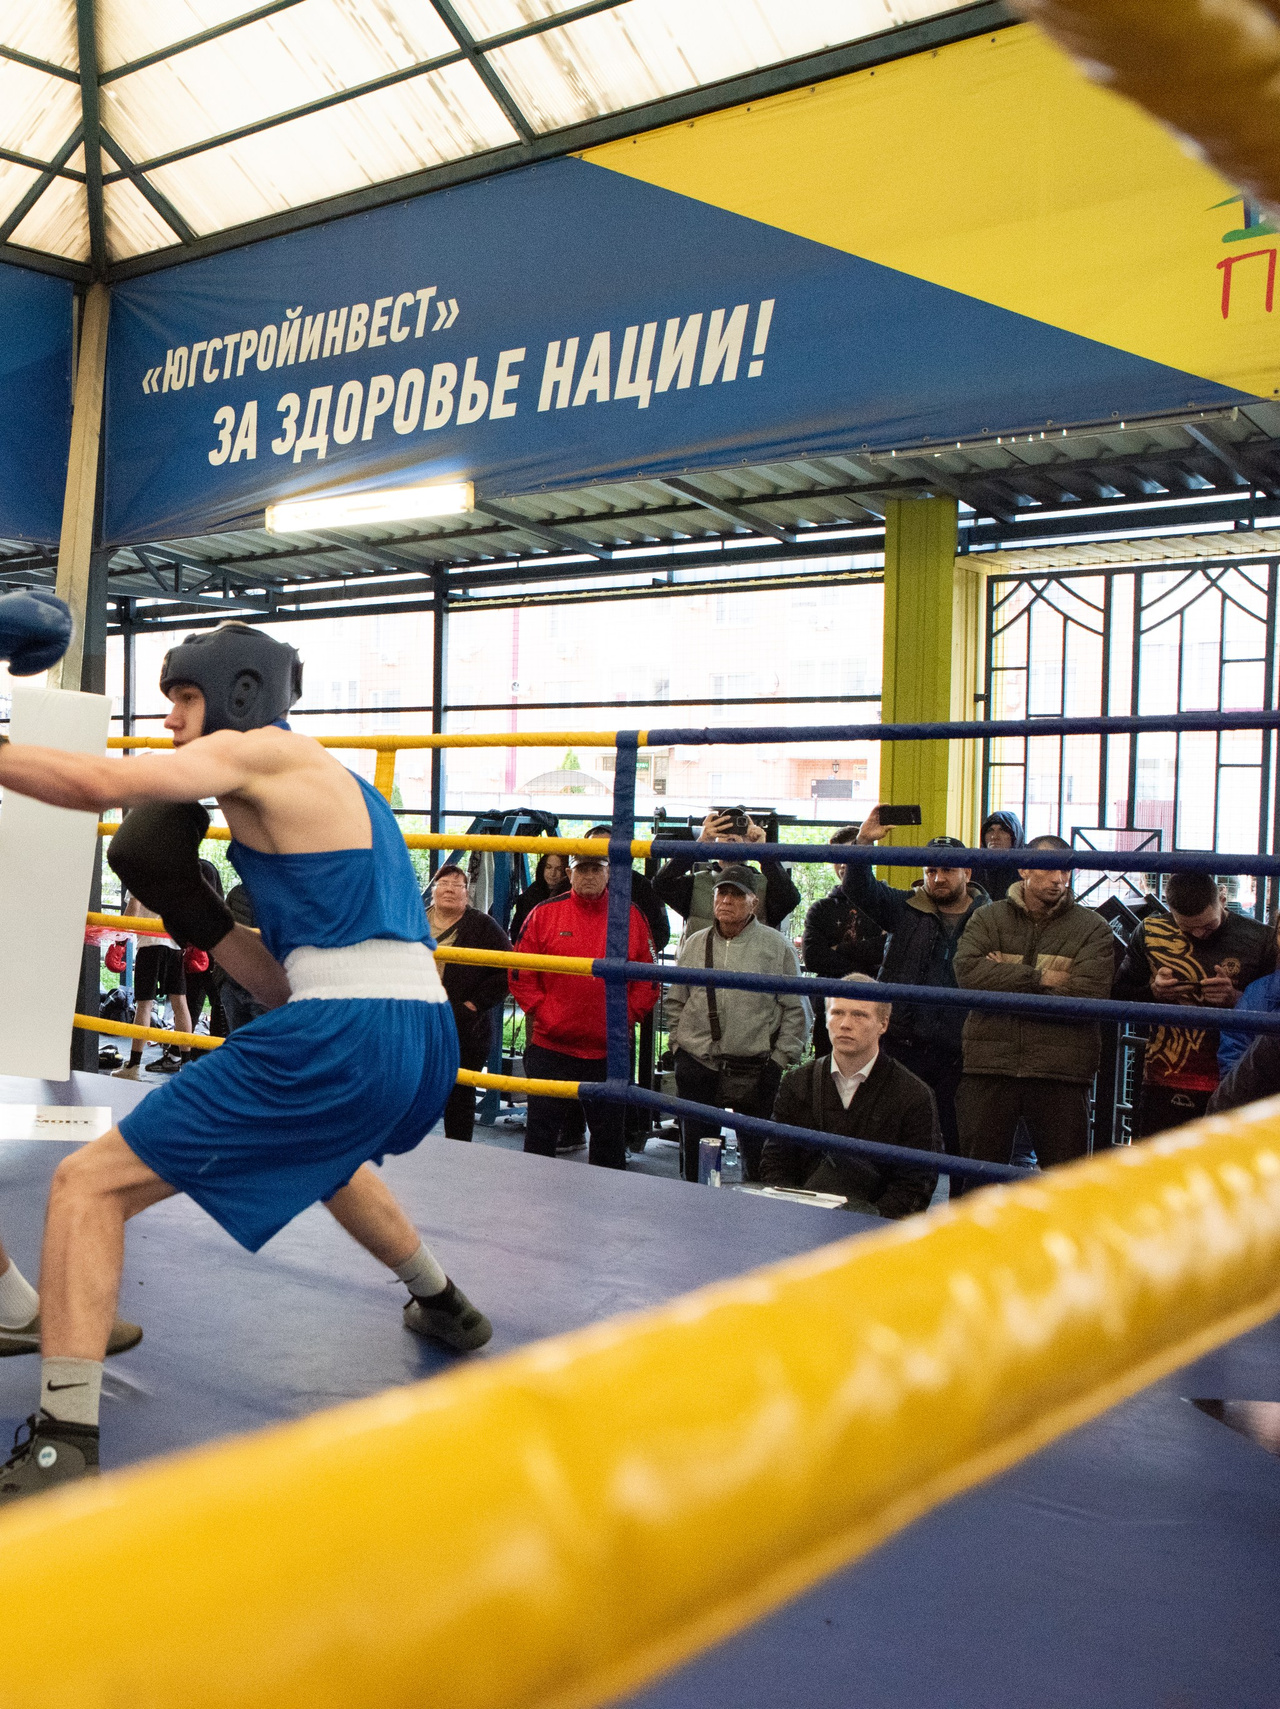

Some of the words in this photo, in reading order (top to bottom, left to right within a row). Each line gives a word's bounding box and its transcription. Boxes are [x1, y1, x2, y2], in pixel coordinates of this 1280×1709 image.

[141, 285, 460, 395] «ЮГСТРОЙИНВЕСТ»
[207, 398, 258, 466] ЗА
[271, 347, 526, 464] ЗДОРОВЬЕ
[537, 298, 776, 412] НАЦИИ!
